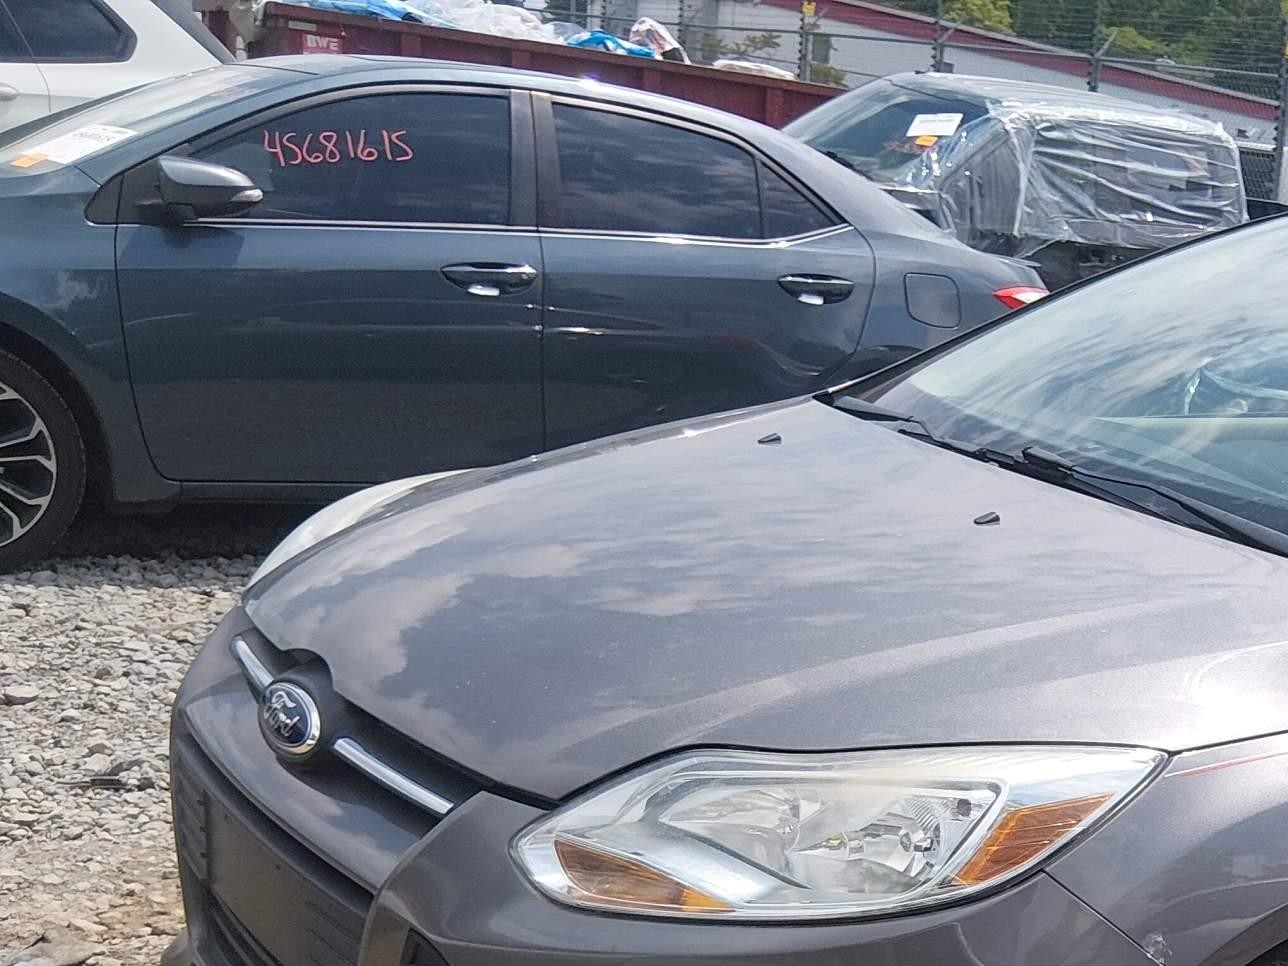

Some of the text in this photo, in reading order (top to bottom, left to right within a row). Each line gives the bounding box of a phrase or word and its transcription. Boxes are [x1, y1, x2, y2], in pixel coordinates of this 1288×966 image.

[306, 34, 339, 51] BWE
[263, 129, 414, 167] 45681615
[263, 691, 300, 737] Ford
